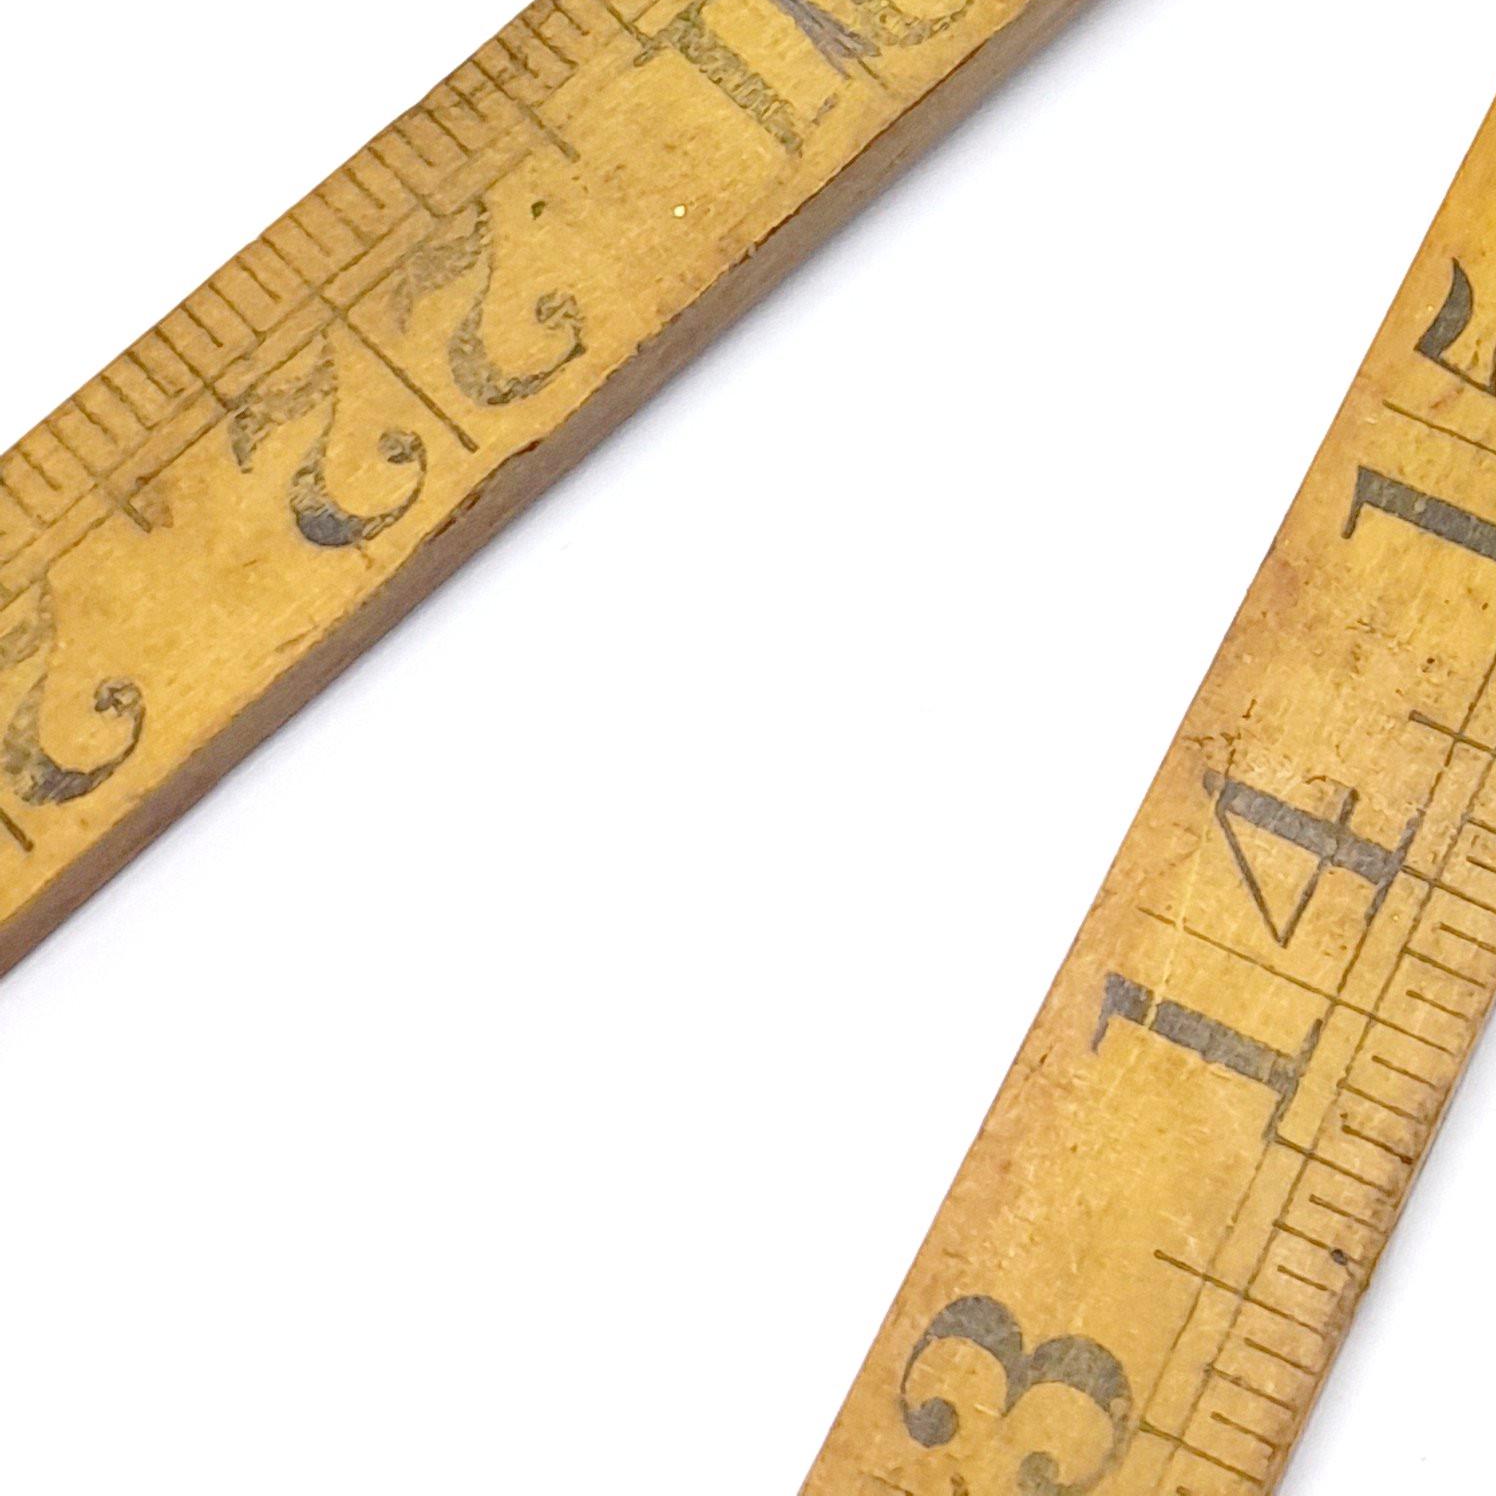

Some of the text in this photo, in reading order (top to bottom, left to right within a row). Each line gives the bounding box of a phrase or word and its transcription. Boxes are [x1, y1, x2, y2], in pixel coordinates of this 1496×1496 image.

[229, 192, 585, 547] 22
[0, 570, 145, 806] 2
[1092, 769, 1424, 1142] 14
[900, 1294, 1133, 1496] 3
